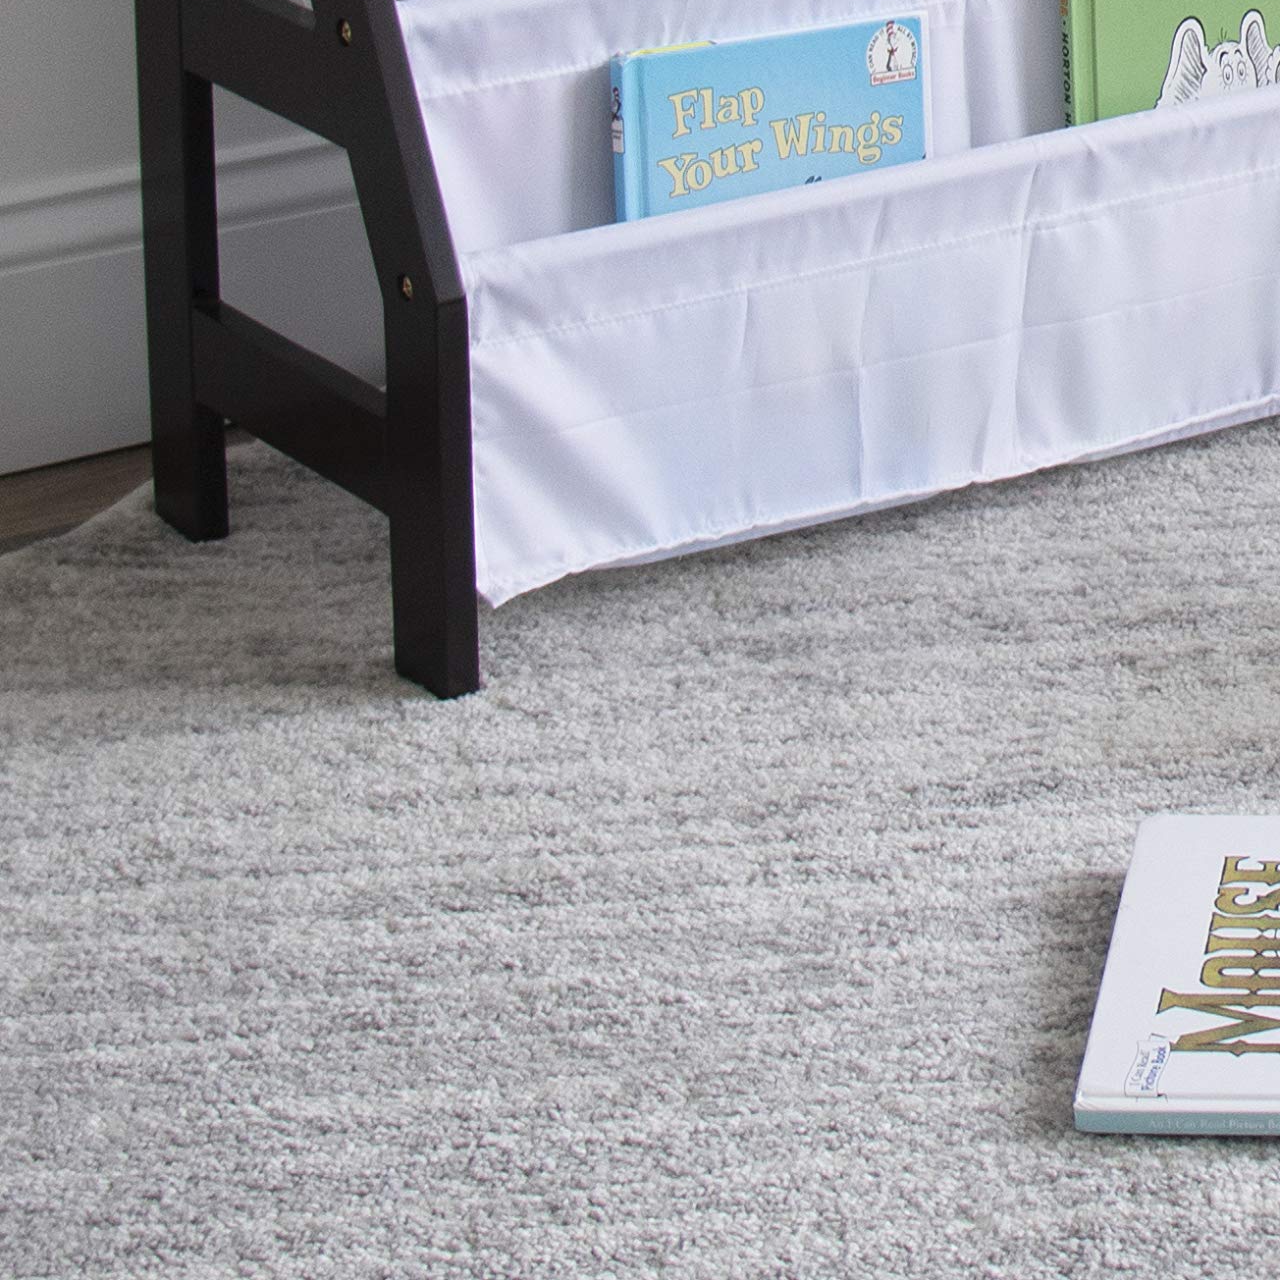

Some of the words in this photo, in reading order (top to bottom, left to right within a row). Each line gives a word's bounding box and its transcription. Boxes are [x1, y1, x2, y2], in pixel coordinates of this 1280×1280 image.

[1062, 32, 1073, 105] HORTON
[668, 86, 766, 140] Flap
[656, 138, 764, 199] Your
[769, 110, 904, 166] Wings
